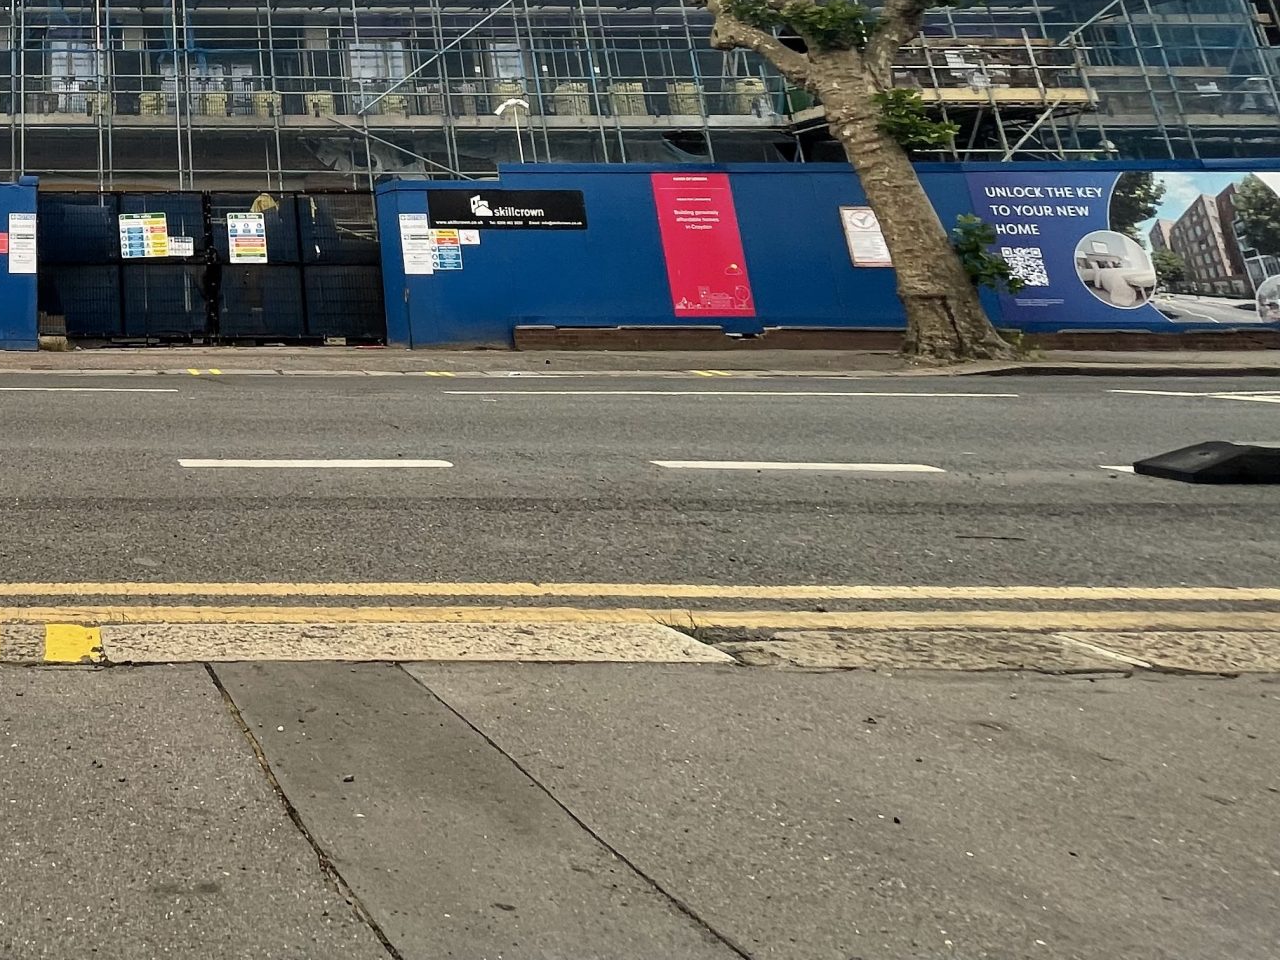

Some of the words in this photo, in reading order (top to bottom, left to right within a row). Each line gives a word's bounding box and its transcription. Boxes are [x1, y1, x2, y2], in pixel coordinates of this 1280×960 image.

[985, 187, 1044, 197] UNLOCK
[1045, 187, 1074, 197] THE
[1076, 187, 1102, 198] KEY
[494, 206, 544, 217] skillcrown
[989, 205, 1010, 216] TO
[1013, 205, 1054, 216] YOUR
[1057, 206, 1089, 216] NEW
[996, 224, 1040, 235] HOME
